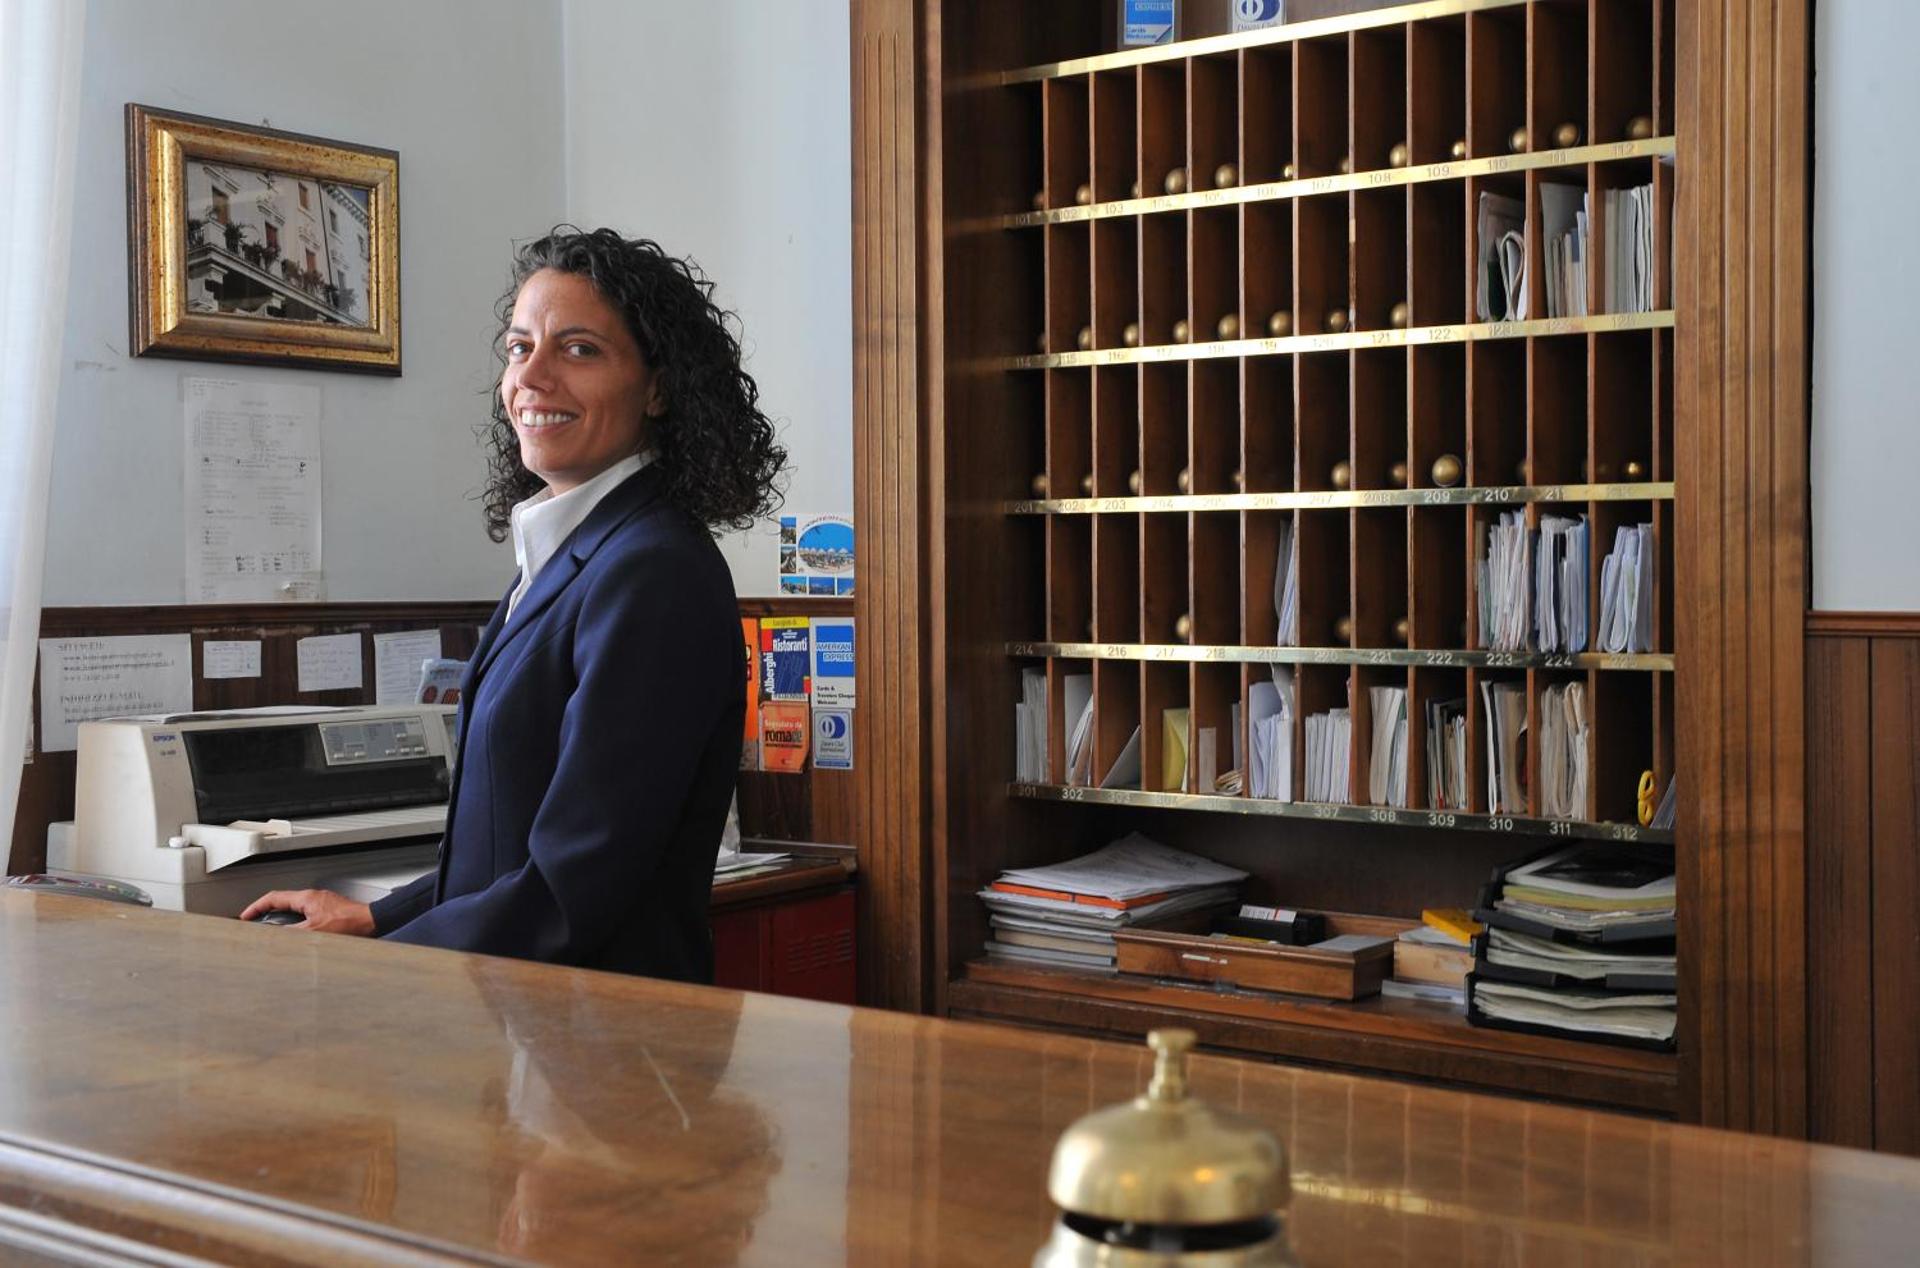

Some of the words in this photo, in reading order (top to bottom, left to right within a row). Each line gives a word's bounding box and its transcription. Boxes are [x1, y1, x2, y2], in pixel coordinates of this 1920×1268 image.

[1105, 203, 1124, 215] 103
[1368, 173, 1391, 185] 108
[1426, 165, 1450, 178] 109
[1487, 158, 1508, 171] 110
[1371, 332, 1391, 344] 121
[1428, 328, 1450, 341] 122
[1014, 501, 1033, 513] 201
[1104, 499, 1126, 511] 203
[1424, 490, 1450, 503] 209
[1484, 489, 1509, 501] 210
[773, 637, 808, 652] Ristoranti
[1015, 644, 1033, 655] 214
[1107, 646, 1127, 657] 216
[1205, 647, 1226, 659] 218
[1369, 651, 1393, 664] 221
[1426, 652, 1453, 665] 222
[1485, 652, 1514, 666] 223
[1544, 654, 1572, 667] 224
[763, 652, 777, 694] Alberghi
[1061, 787, 1084, 800] 302
[1313, 805, 1339, 818] 307
[1369, 809, 1396, 823] 308
[1427, 813, 1455, 827] 309
[1488, 816, 1514, 831] 310
[1549, 821, 1571, 835] 311
[1612, 826, 1638, 840] 312
